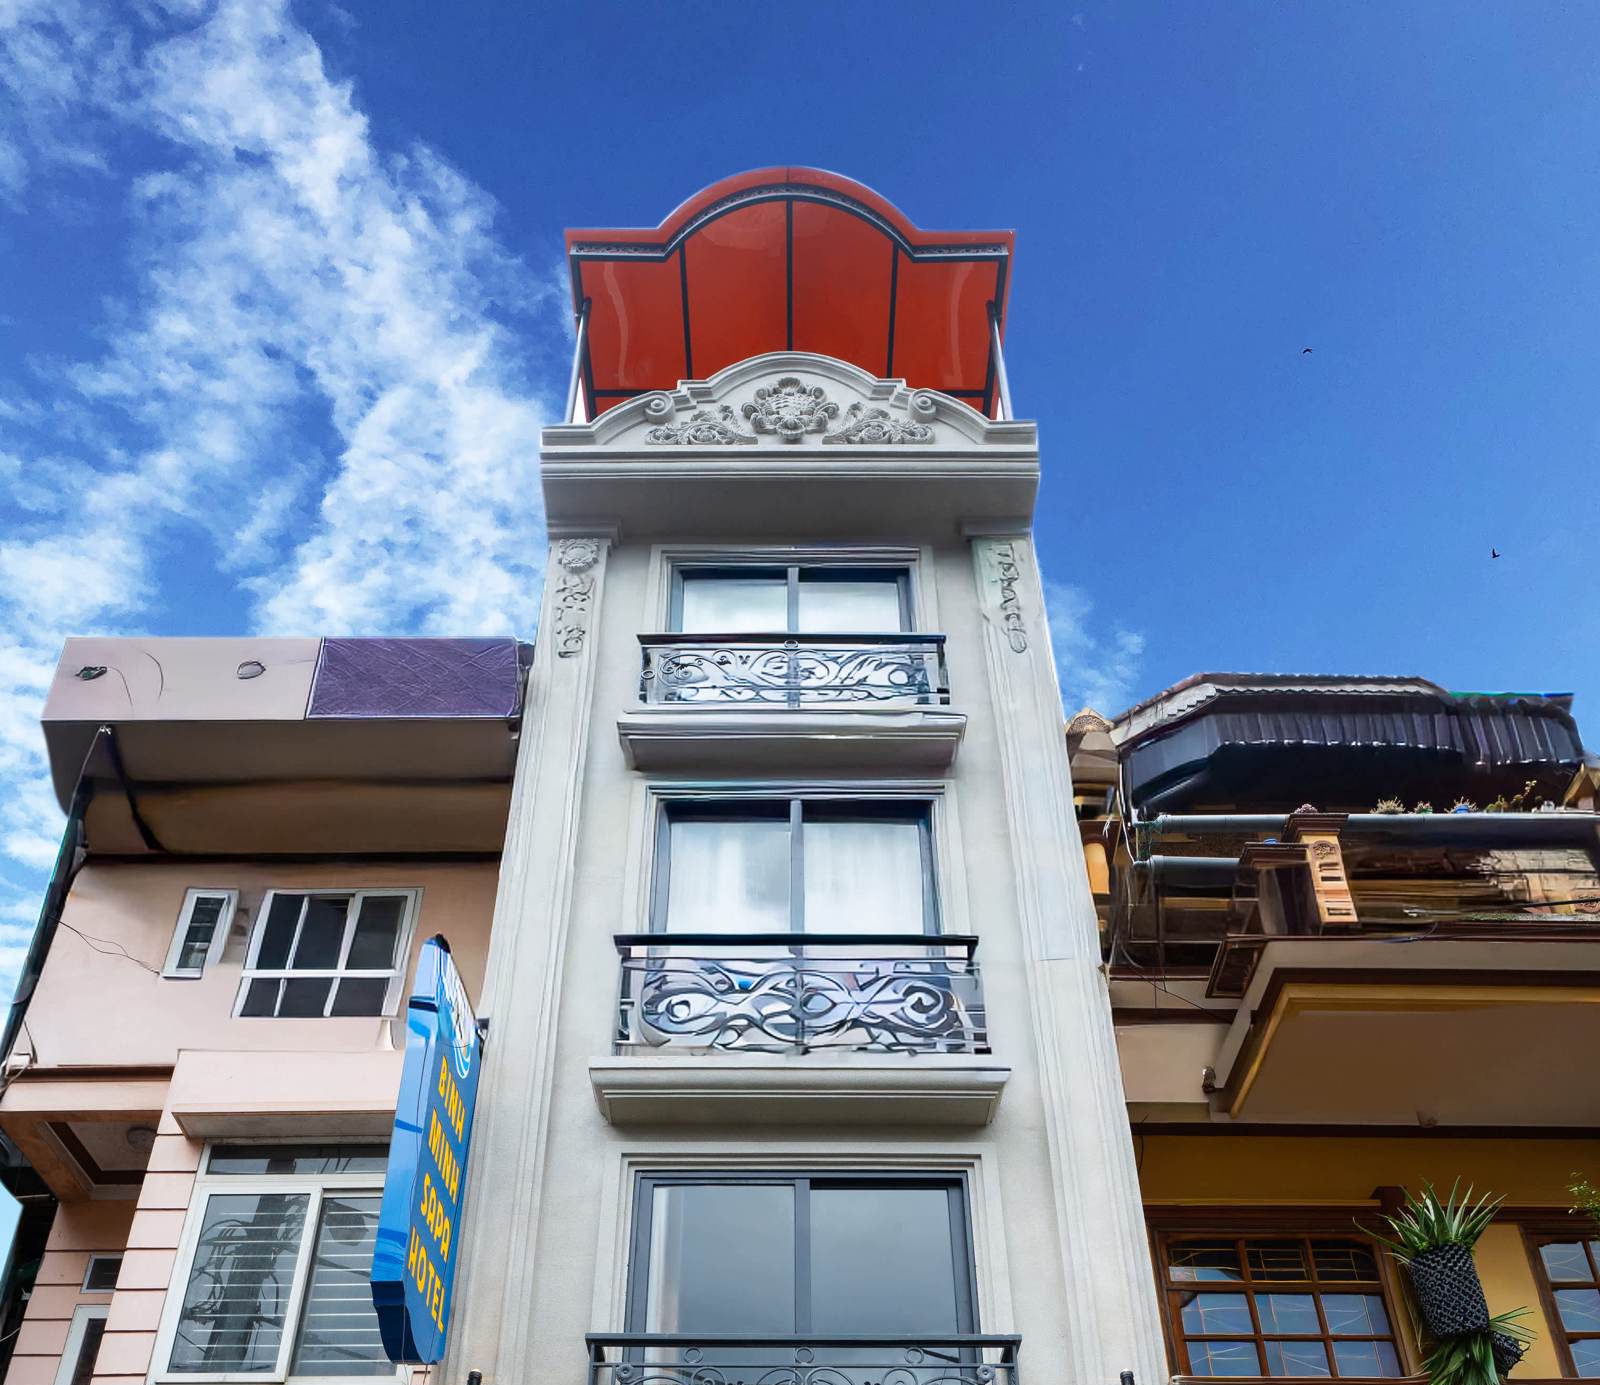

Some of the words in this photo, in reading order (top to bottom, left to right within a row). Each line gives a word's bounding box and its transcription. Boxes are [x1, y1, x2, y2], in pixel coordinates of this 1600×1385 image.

[438, 1055, 465, 1143] BINH
[428, 1106, 460, 1204] MINH
[420, 1172, 451, 1262] SAPA
[408, 1225, 445, 1334] HOTEL
